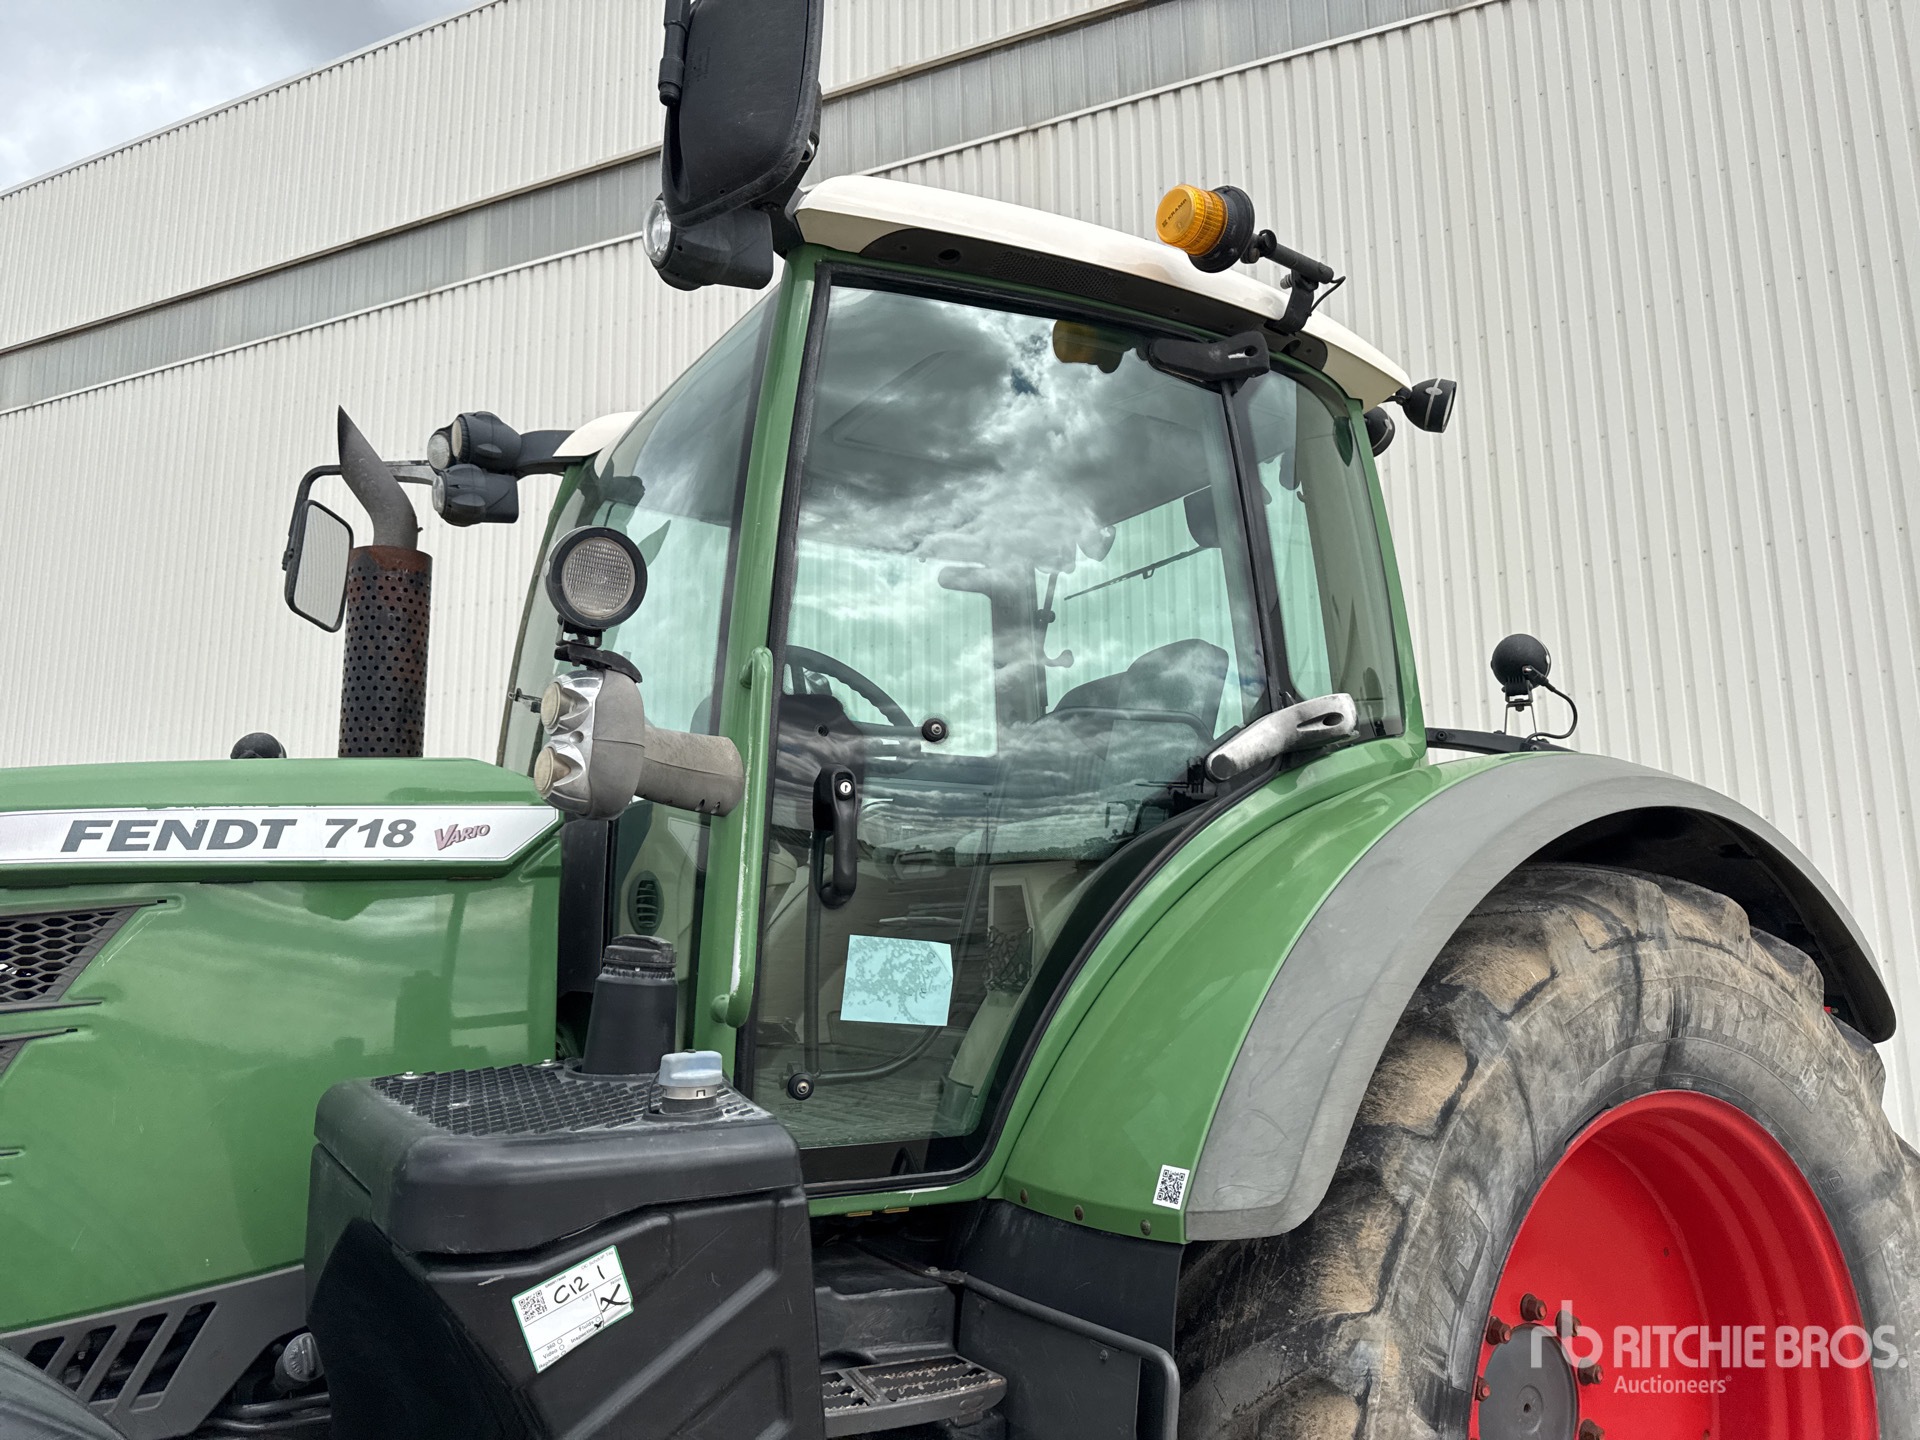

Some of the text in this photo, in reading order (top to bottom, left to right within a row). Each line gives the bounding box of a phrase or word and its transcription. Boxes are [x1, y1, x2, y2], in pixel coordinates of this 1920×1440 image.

[59, 818, 297, 852] FENDT
[324, 818, 416, 849] 718
[542, 1348, 558, 1360] Video
